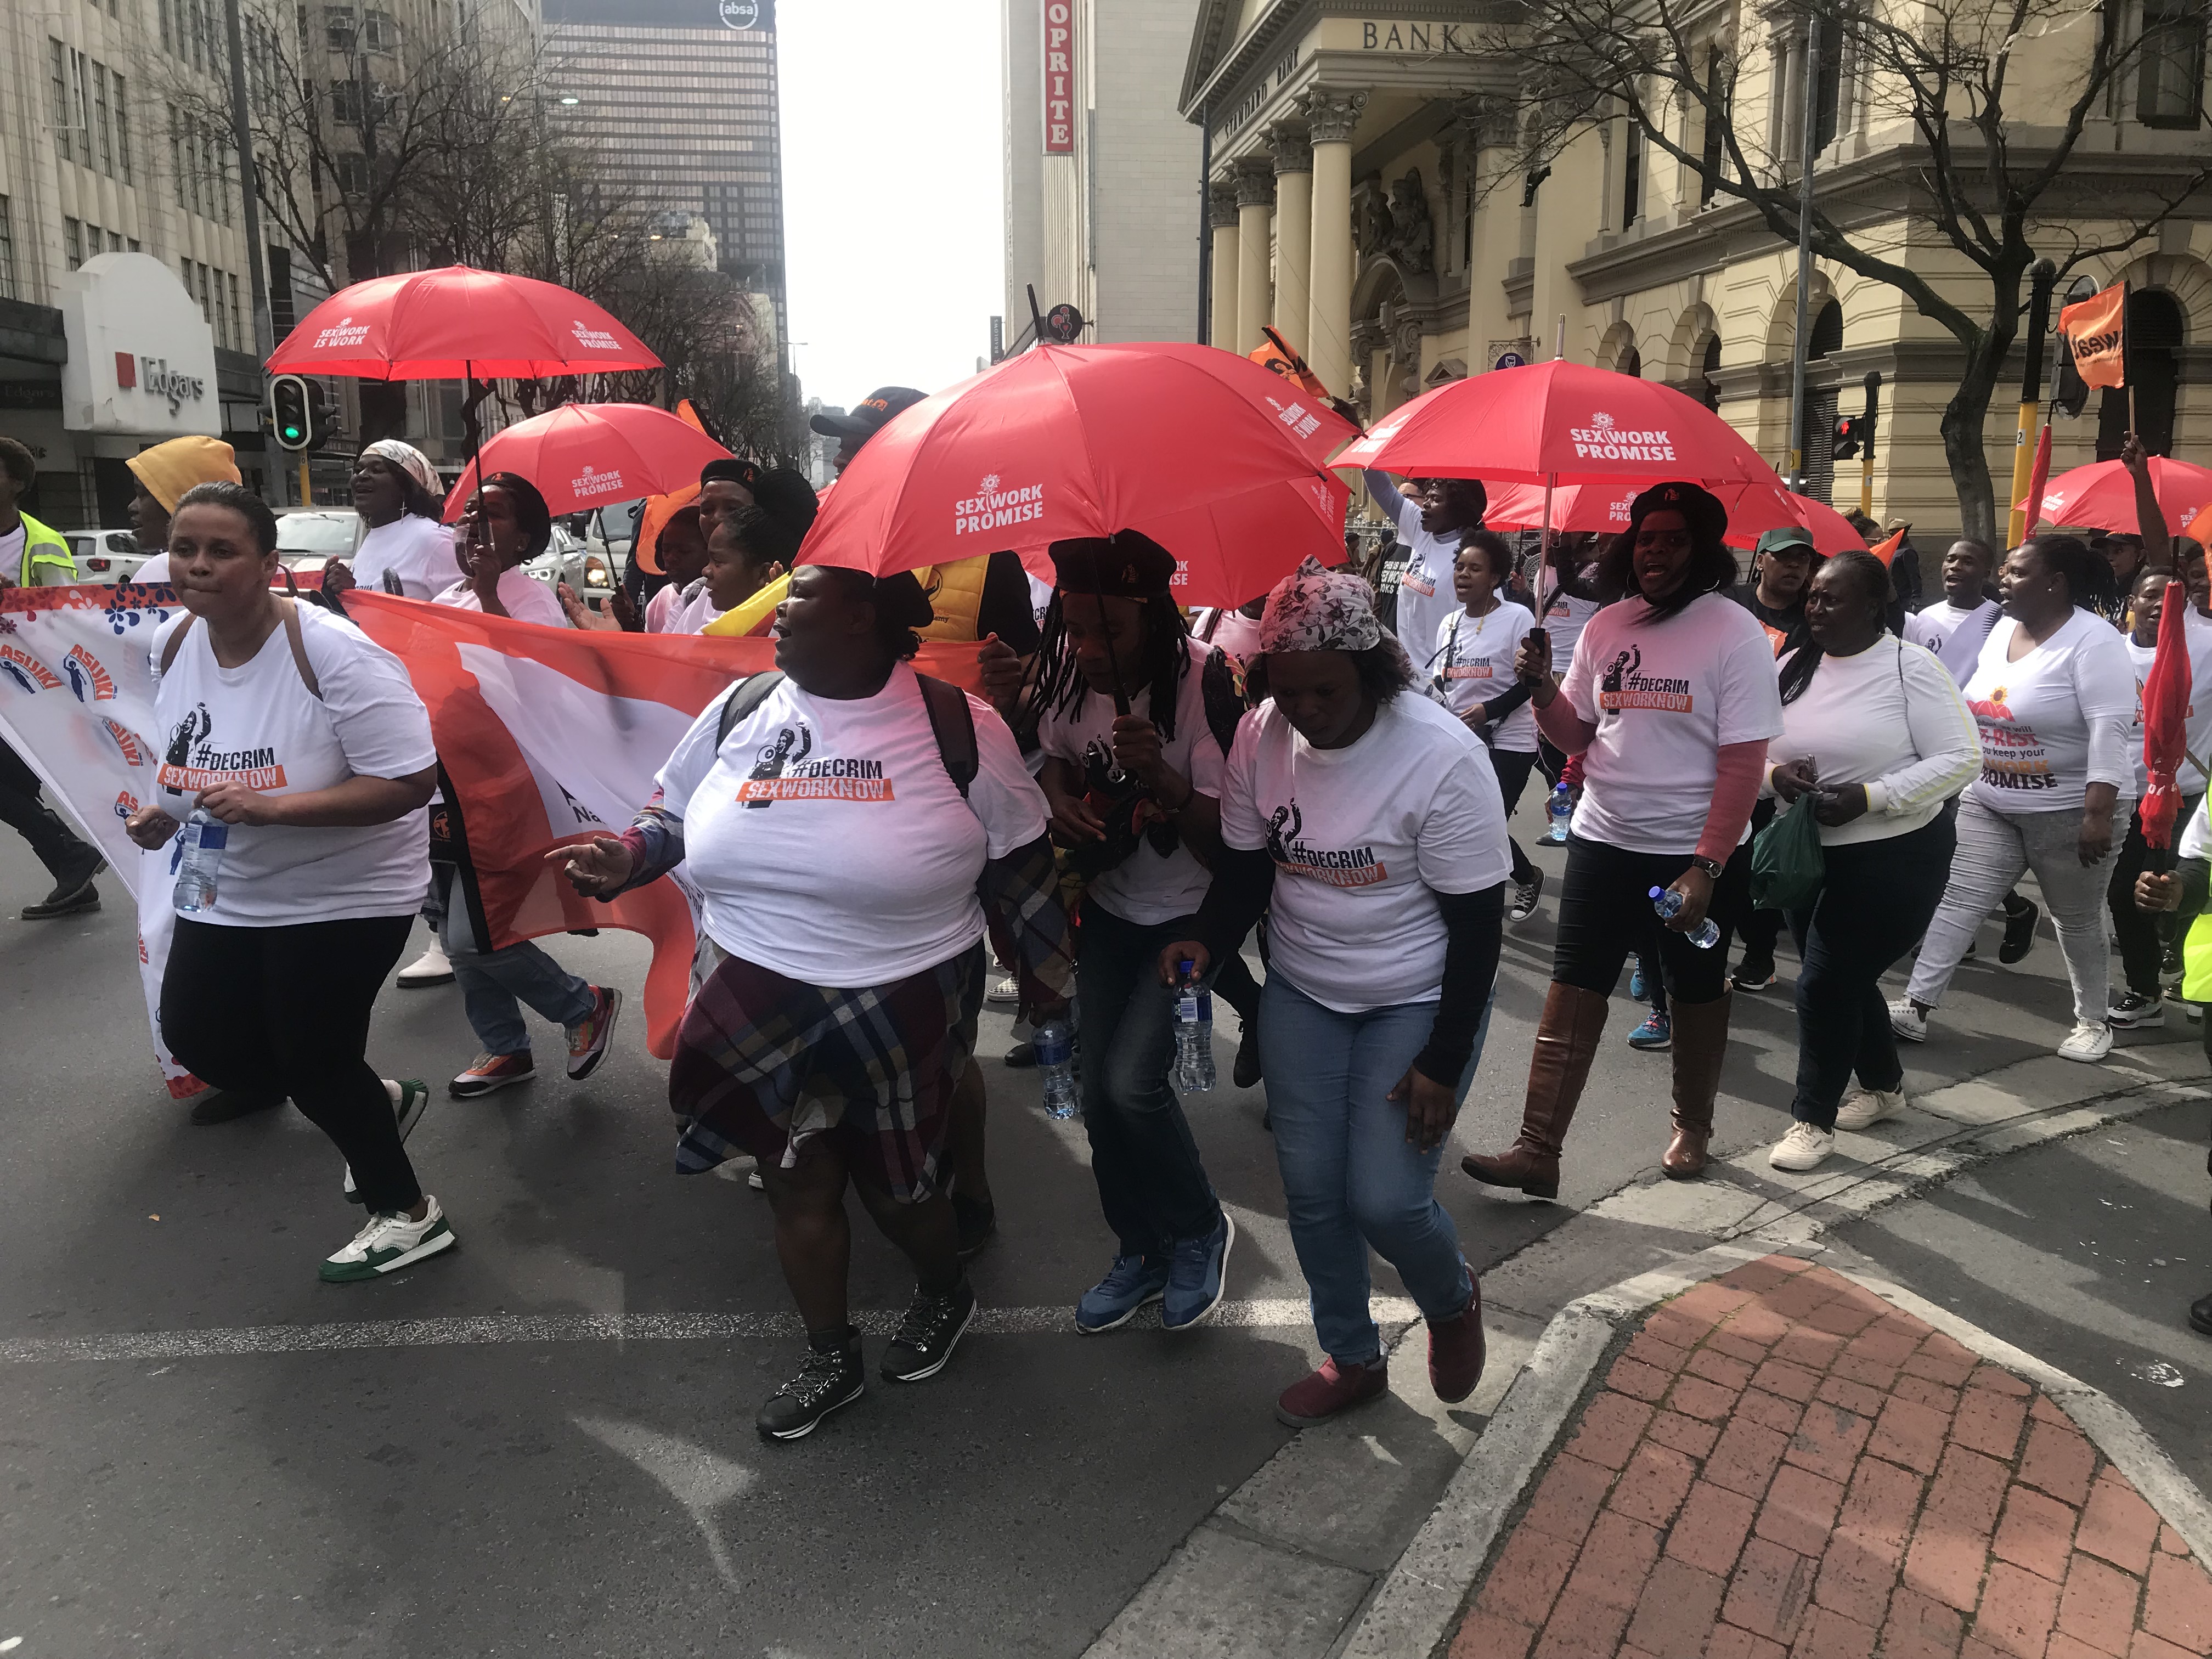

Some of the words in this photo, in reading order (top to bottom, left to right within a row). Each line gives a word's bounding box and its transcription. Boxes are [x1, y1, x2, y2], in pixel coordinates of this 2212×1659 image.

[725, 2, 754, 15] absa
[1363, 22, 1464, 53] BANK
[1224, 82, 1268, 138] STANDARD
[1277, 45, 1300, 84] BANK
[319, 329, 338, 338] SEX
[338, 325, 371, 336] WORK
[313, 338, 328, 348] IS
[328, 335, 366, 347] WORK
[579, 338, 622, 349] PROMISE
[140, 357, 205, 417] Edgars
[1293, 426, 1308, 439] IS
[1297, 413, 1322, 435] WORK
[1570, 428, 1606, 443] SEX
[1607, 431, 1672, 444] WORK
[2018, 432, 2022, 443] 2
[1575, 443, 1677, 461] PROMISE
[572, 477, 590, 488] SEX
[590, 470, 621, 484] WORK
[574, 478, 624, 498] PROMISE
[955, 496, 986, 516] SEX
[989, 483, 1043, 509] WORK
[1610, 502, 1627, 510] SEX
[956, 501, 1043, 535] PROMISE
[0, 644, 64, 690] ASIJIKI
[1455, 655, 1490, 667] #DECRIM
[70, 644, 114, 701] ASIJIKI
[1447, 668, 1489, 678] EXWORKNOW
[1628, 672, 1690, 695] #DECRIM
[1604, 692, 1688, 710] SEXWORKNOW
[108, 720, 140, 766] SIJIKI
[1993, 729, 2039, 747] REST
[196, 743, 275, 771] #DECRIM
[1982, 746, 1991, 754] ou
[1993, 747, 2016, 759] keep
[2019, 748, 2045, 759] your
[791, 758, 883, 779] #DECRIM
[1984, 758, 2051, 774] WORK
[1980, 767, 2058, 789] ROMISE
[746, 780, 884, 799] SEXWORKNOW
[1293, 840, 1375, 869] #DECRIM
